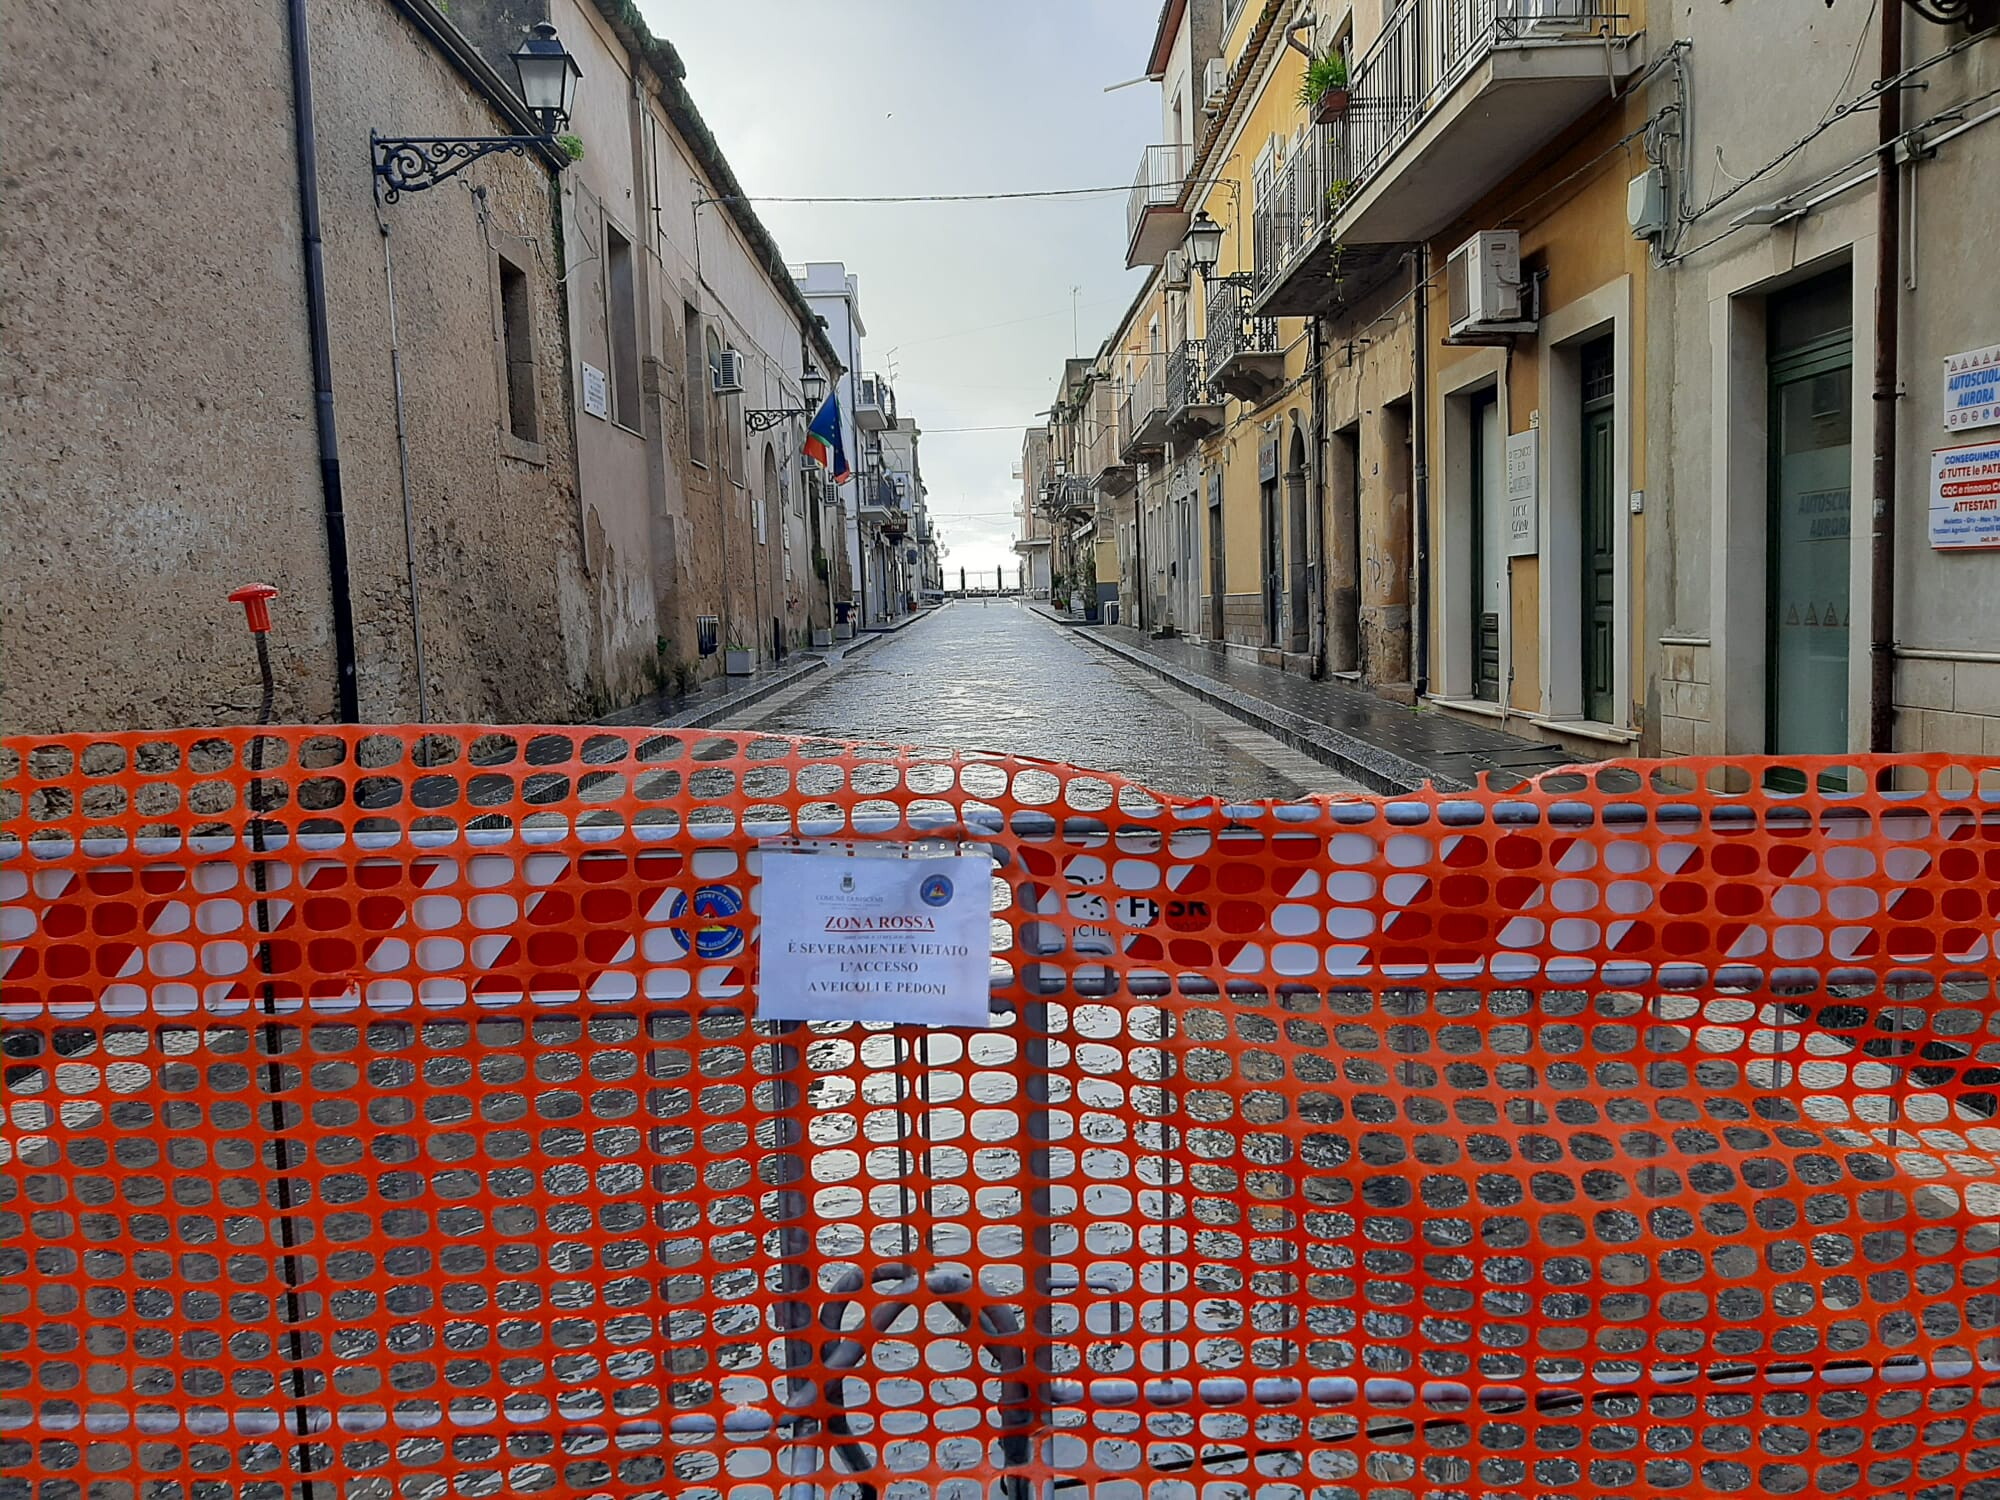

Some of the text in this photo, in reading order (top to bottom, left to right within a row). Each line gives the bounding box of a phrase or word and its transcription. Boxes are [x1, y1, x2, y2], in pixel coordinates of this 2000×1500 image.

[1948, 367, 2000, 391] AUTOSCUOL
[1957, 387, 1995, 408] AURORA
[1944, 451, 2000, 465] CONSEGUIMEN
[1939, 468, 1946, 479] di
[1948, 466, 1971, 478] TUTTE
[1973, 465, 1980, 475] le
[1942, 485, 1957, 495] CQC
[1964, 483, 1991, 493] rinnovo
[1798, 492, 1850, 514] AUTOSCU
[1953, 499, 1997, 512] ATTESTATI
[825, 915, 935, 929] ZONA ROSSA
[788, 939, 968, 956] È SEVERAMENTE VIETATO
[840, 961, 919, 973] L'ACCESSO
[808, 981, 946, 995] A VEICOLI E PEDONI
